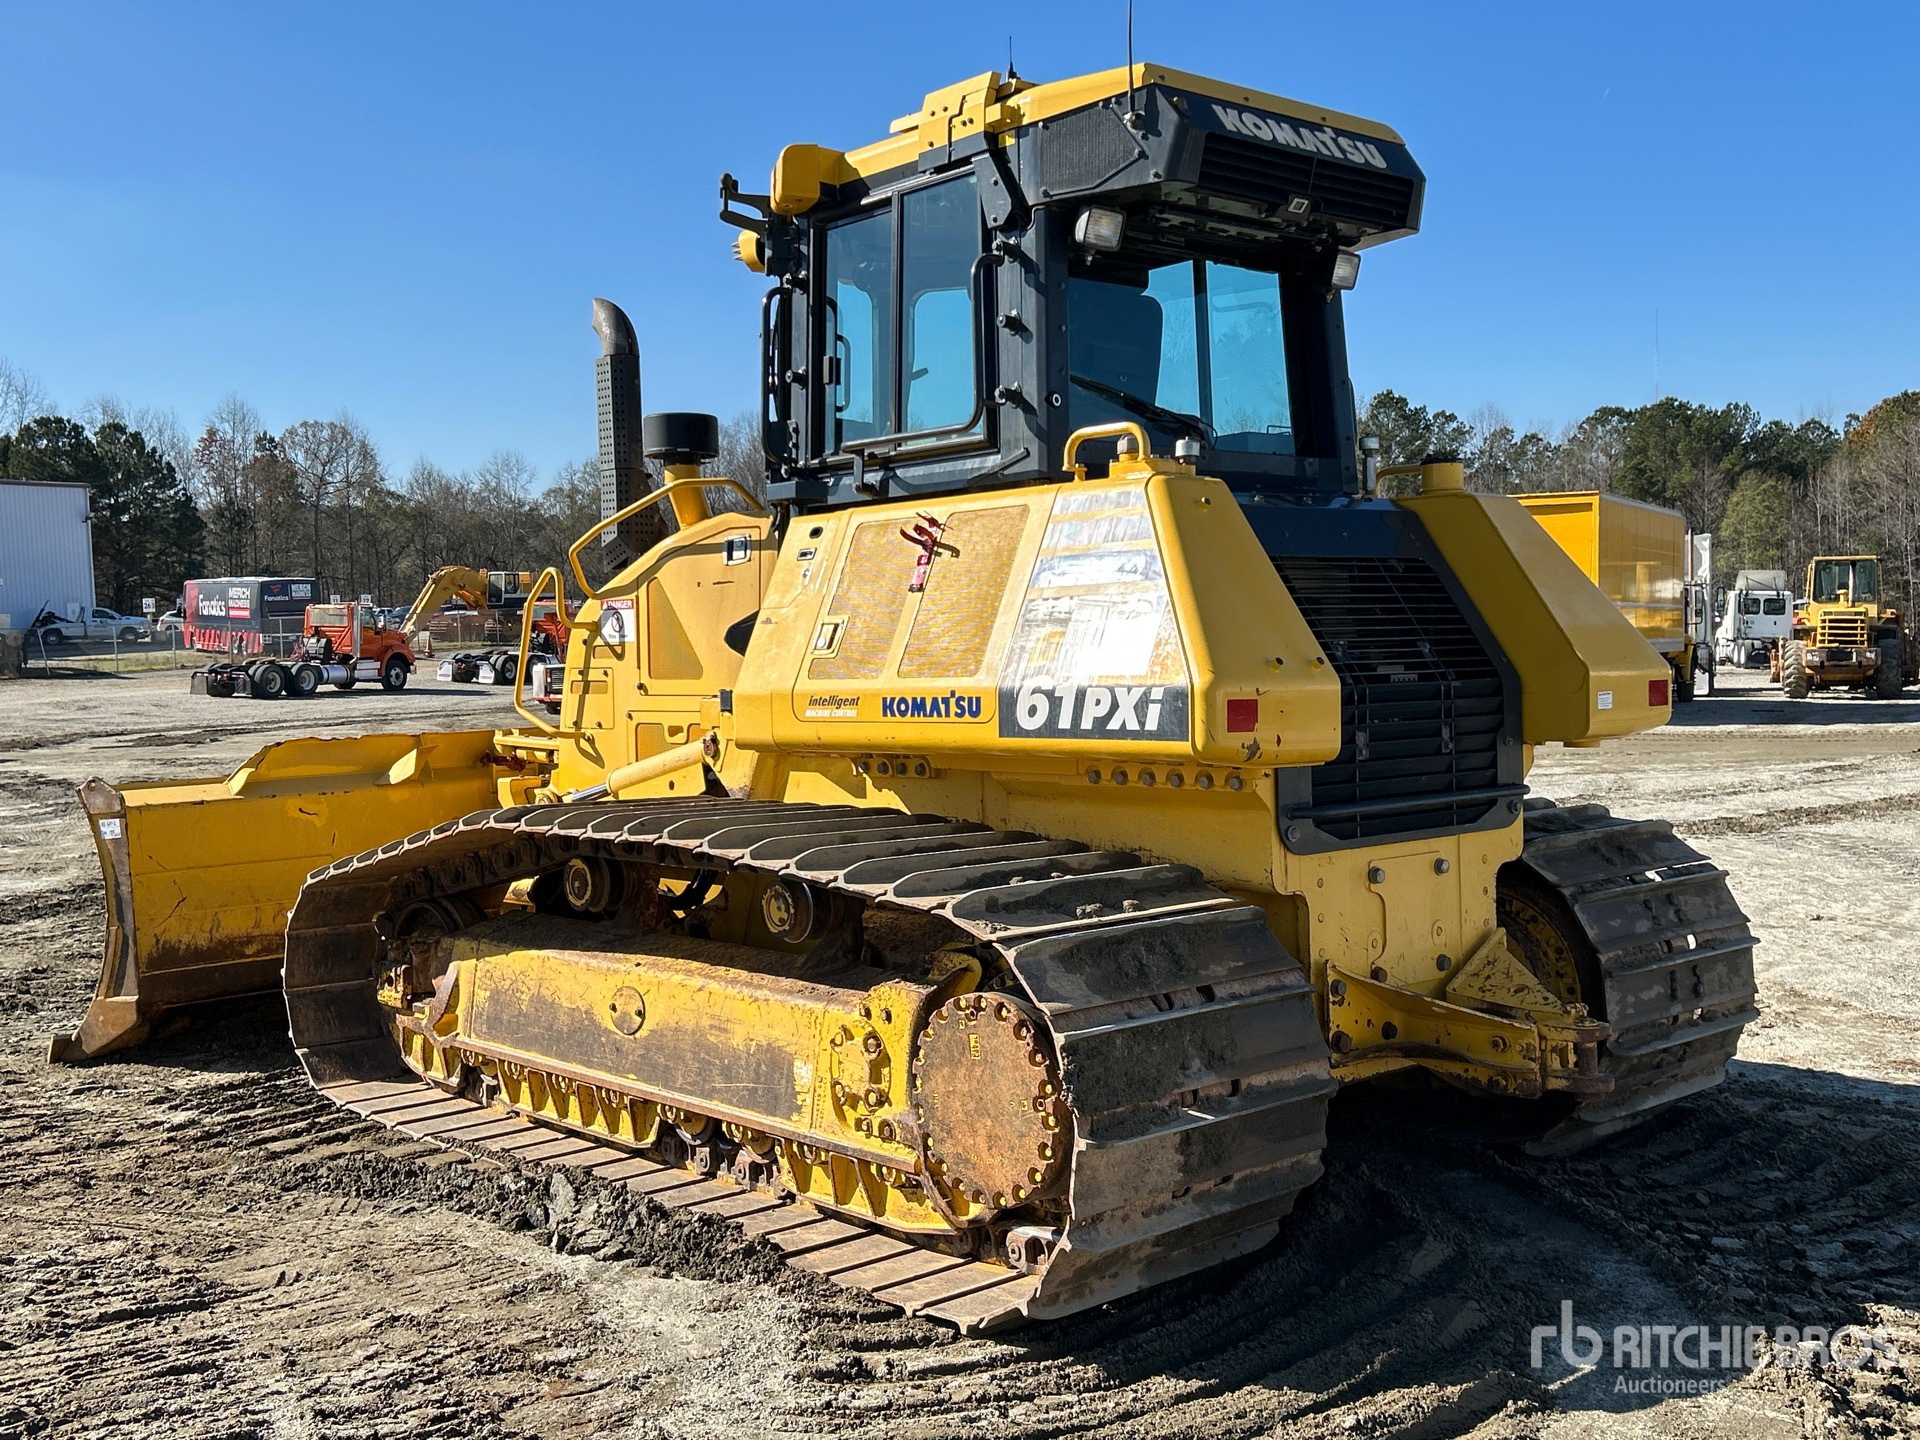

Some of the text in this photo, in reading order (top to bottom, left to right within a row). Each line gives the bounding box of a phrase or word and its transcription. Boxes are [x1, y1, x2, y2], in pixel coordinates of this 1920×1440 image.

[1211, 103, 1388, 169] KOMATSU
[229, 587, 251, 599] MERCH
[199, 594, 226, 616] Fanatics
[608, 600, 632, 609] DANGER
[808, 695, 861, 709] intelligent
[882, 690, 982, 719] KOMATSU
[1016, 676, 1165, 731] 61PXi
